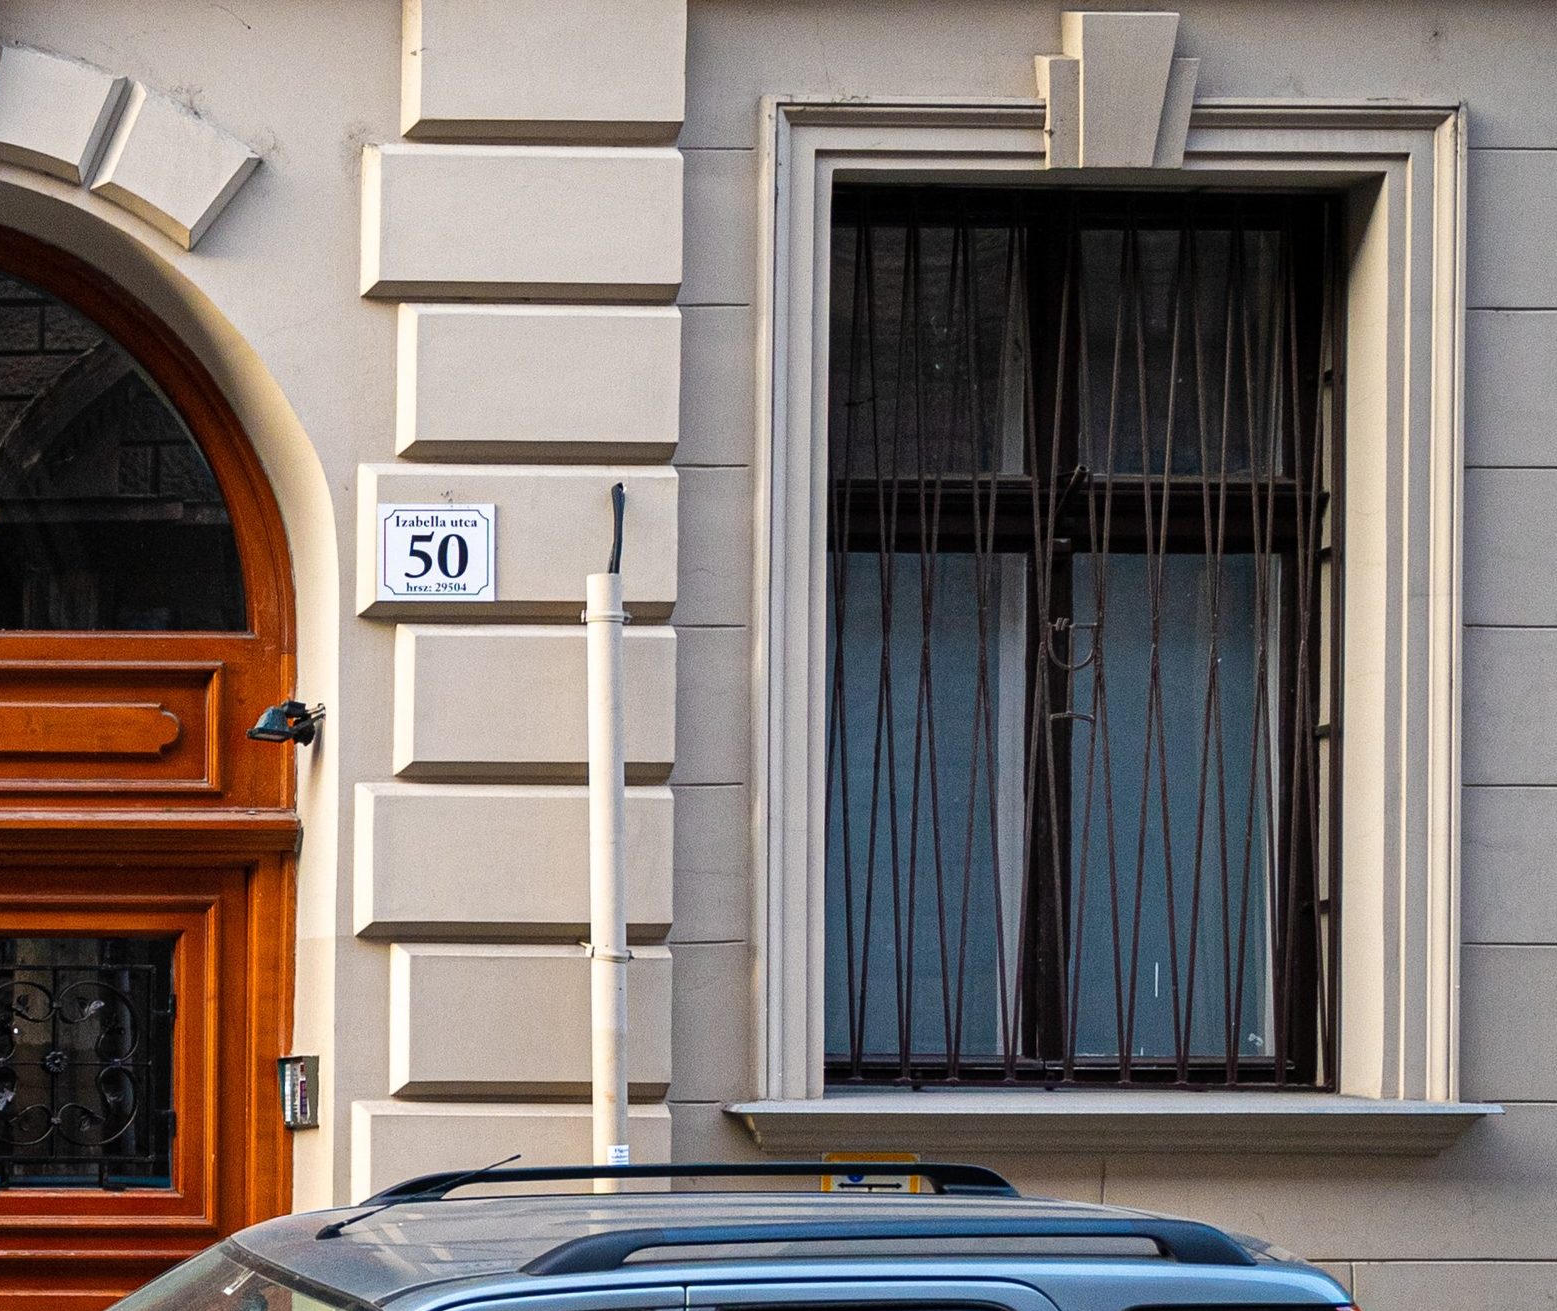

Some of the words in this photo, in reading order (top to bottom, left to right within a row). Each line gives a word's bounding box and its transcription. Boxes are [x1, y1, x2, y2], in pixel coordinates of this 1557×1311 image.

[396, 515, 446, 528] Izabella
[451, 517, 478, 528] utca
[404, 531, 469, 579] 50
[406, 582, 432, 592] hrsz:
[435, 582, 467, 592] 29504
